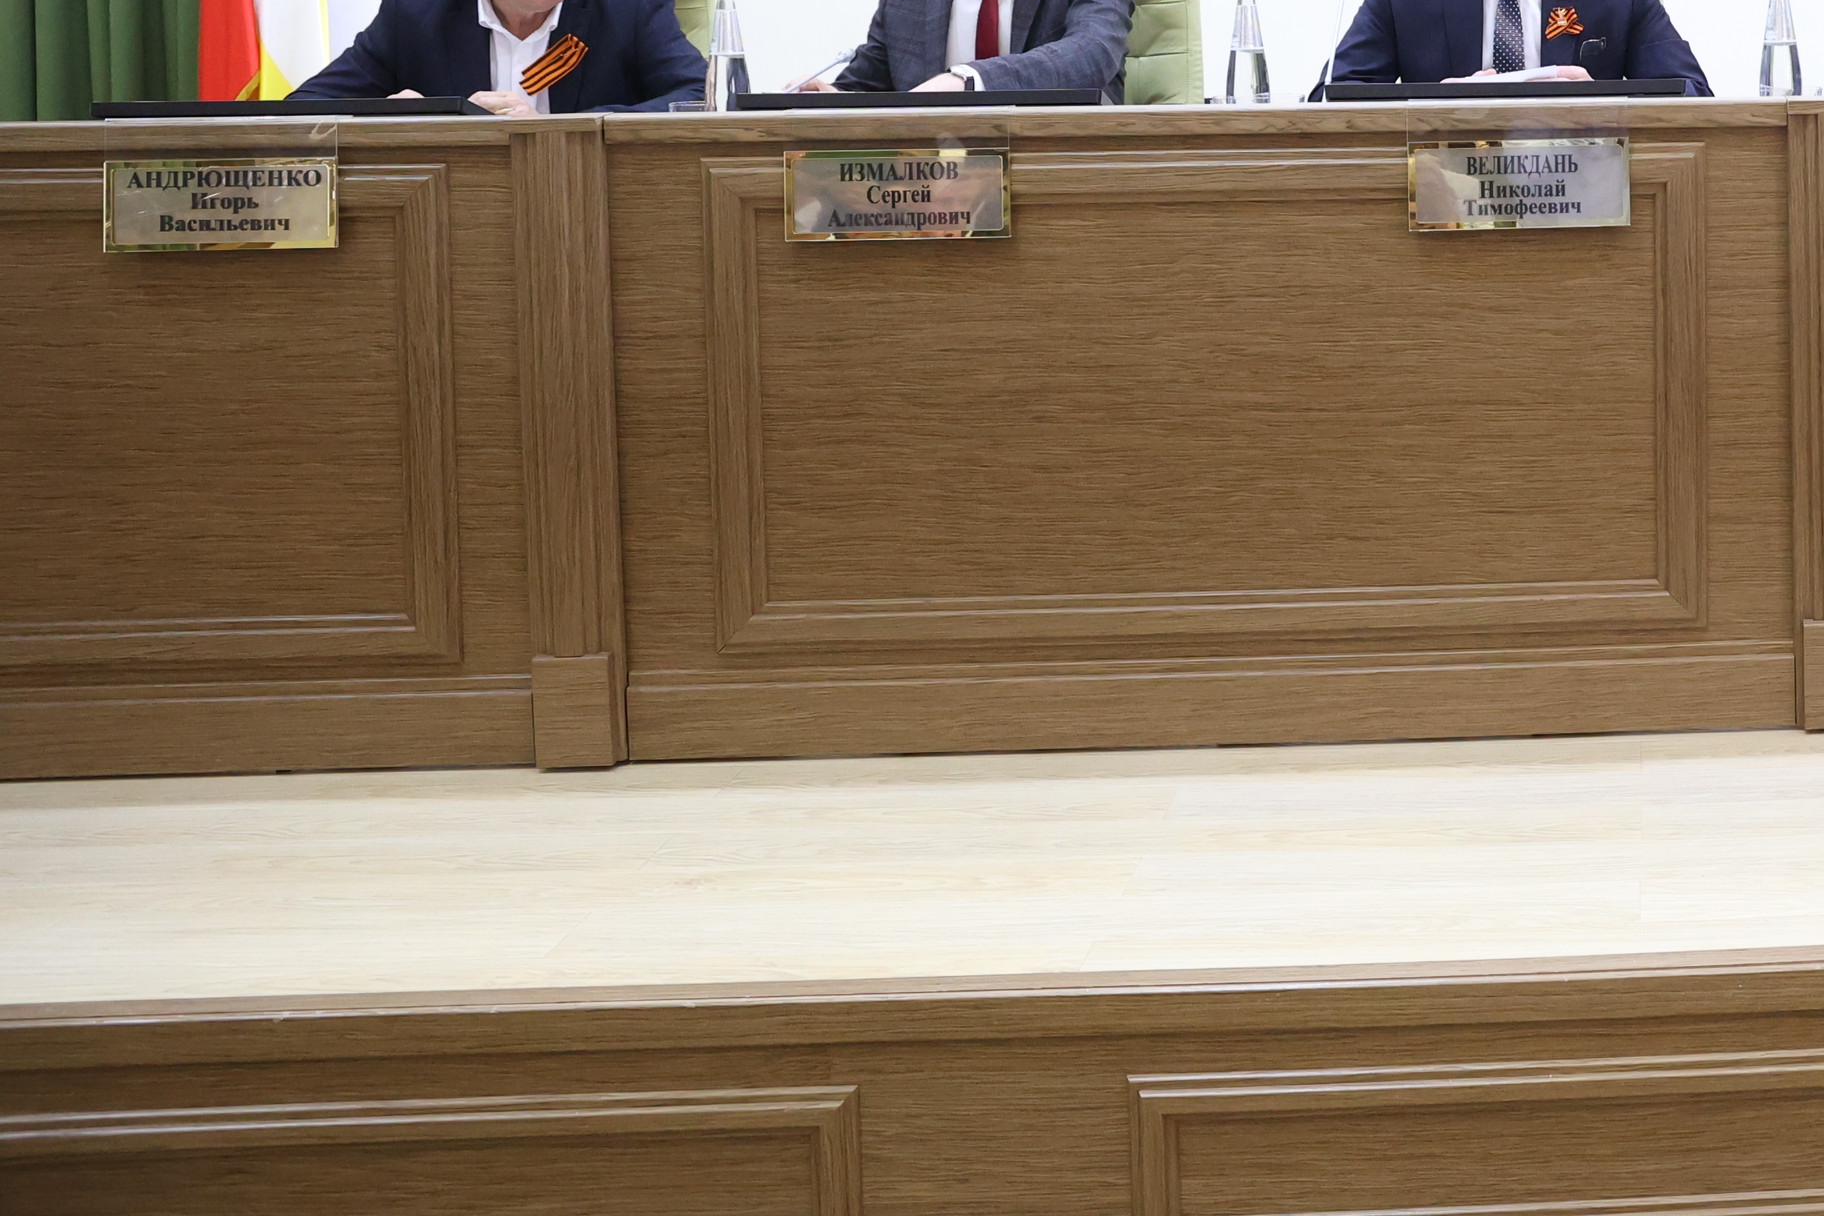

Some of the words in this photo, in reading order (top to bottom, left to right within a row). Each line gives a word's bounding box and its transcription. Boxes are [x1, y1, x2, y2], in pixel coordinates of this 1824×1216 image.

[839, 161, 959, 182] ИЗМАЛКОВ
[1466, 153, 1578, 178] ВЕЛИКДАНЬ
[127, 169, 322, 191] АНДРЮЩЕНКО
[1479, 180, 1566, 199] Николай
[191, 192, 259, 213] Игорь
[866, 185, 931, 208] Сергей
[828, 208, 971, 231] Александрович
[1463, 199, 1581, 219] Тимофеевич
[159, 215, 290, 232] Васильевич
